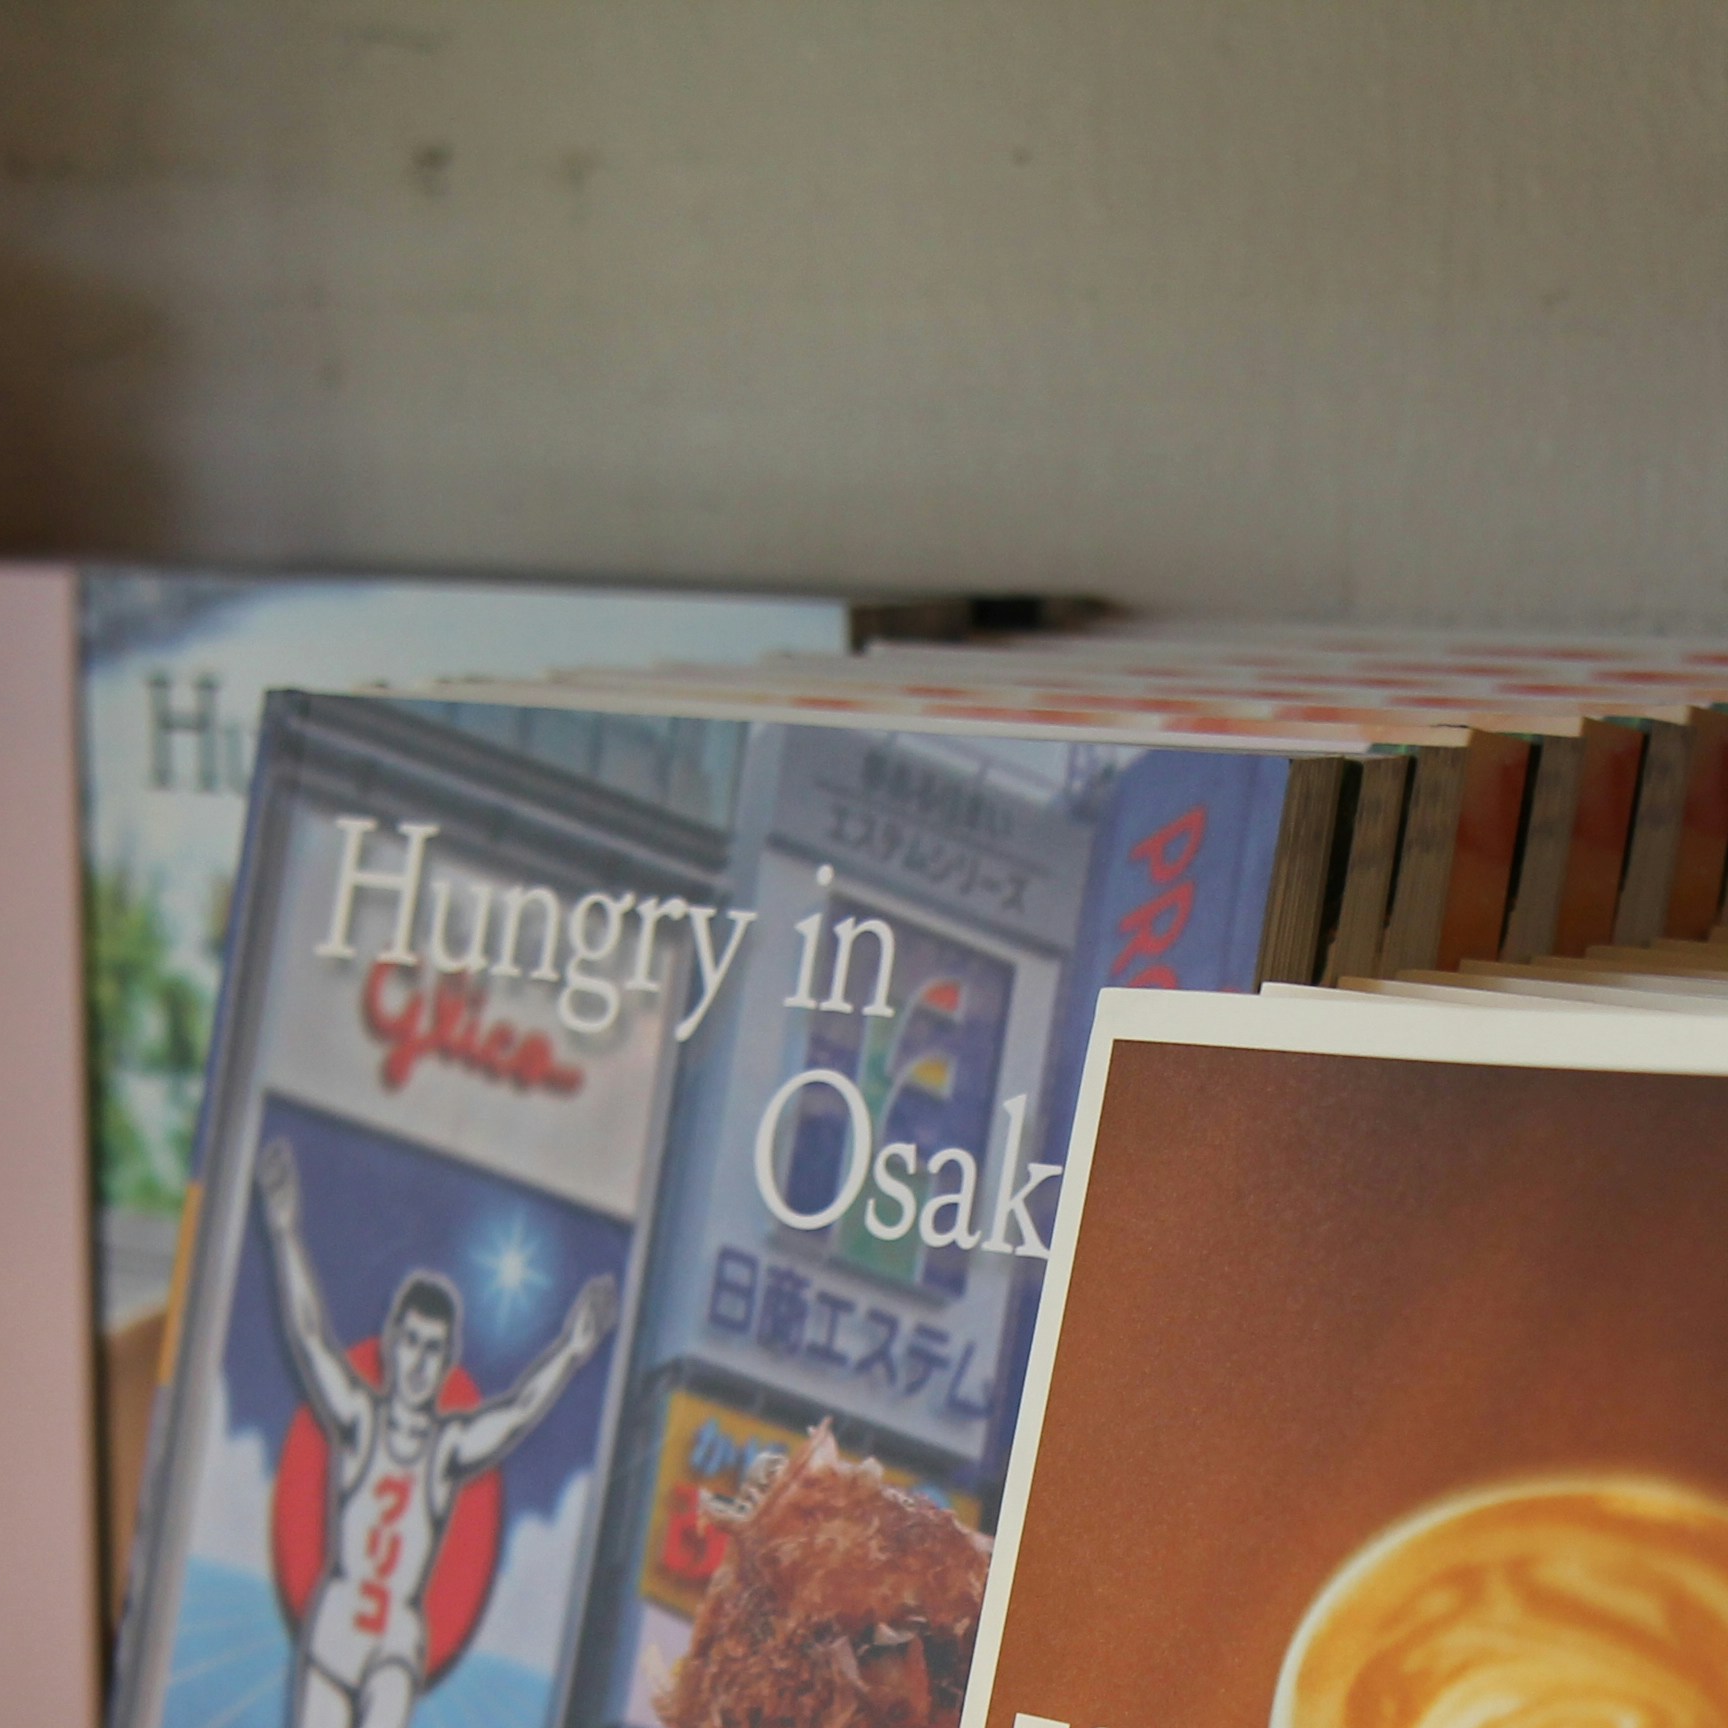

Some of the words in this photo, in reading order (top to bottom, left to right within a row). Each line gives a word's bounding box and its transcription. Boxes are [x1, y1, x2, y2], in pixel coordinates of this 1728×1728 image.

[314, 816, 756, 1041] Hungry
[783, 863, 898, 1018] in
[754, 1068, 1064, 1260] Osak
